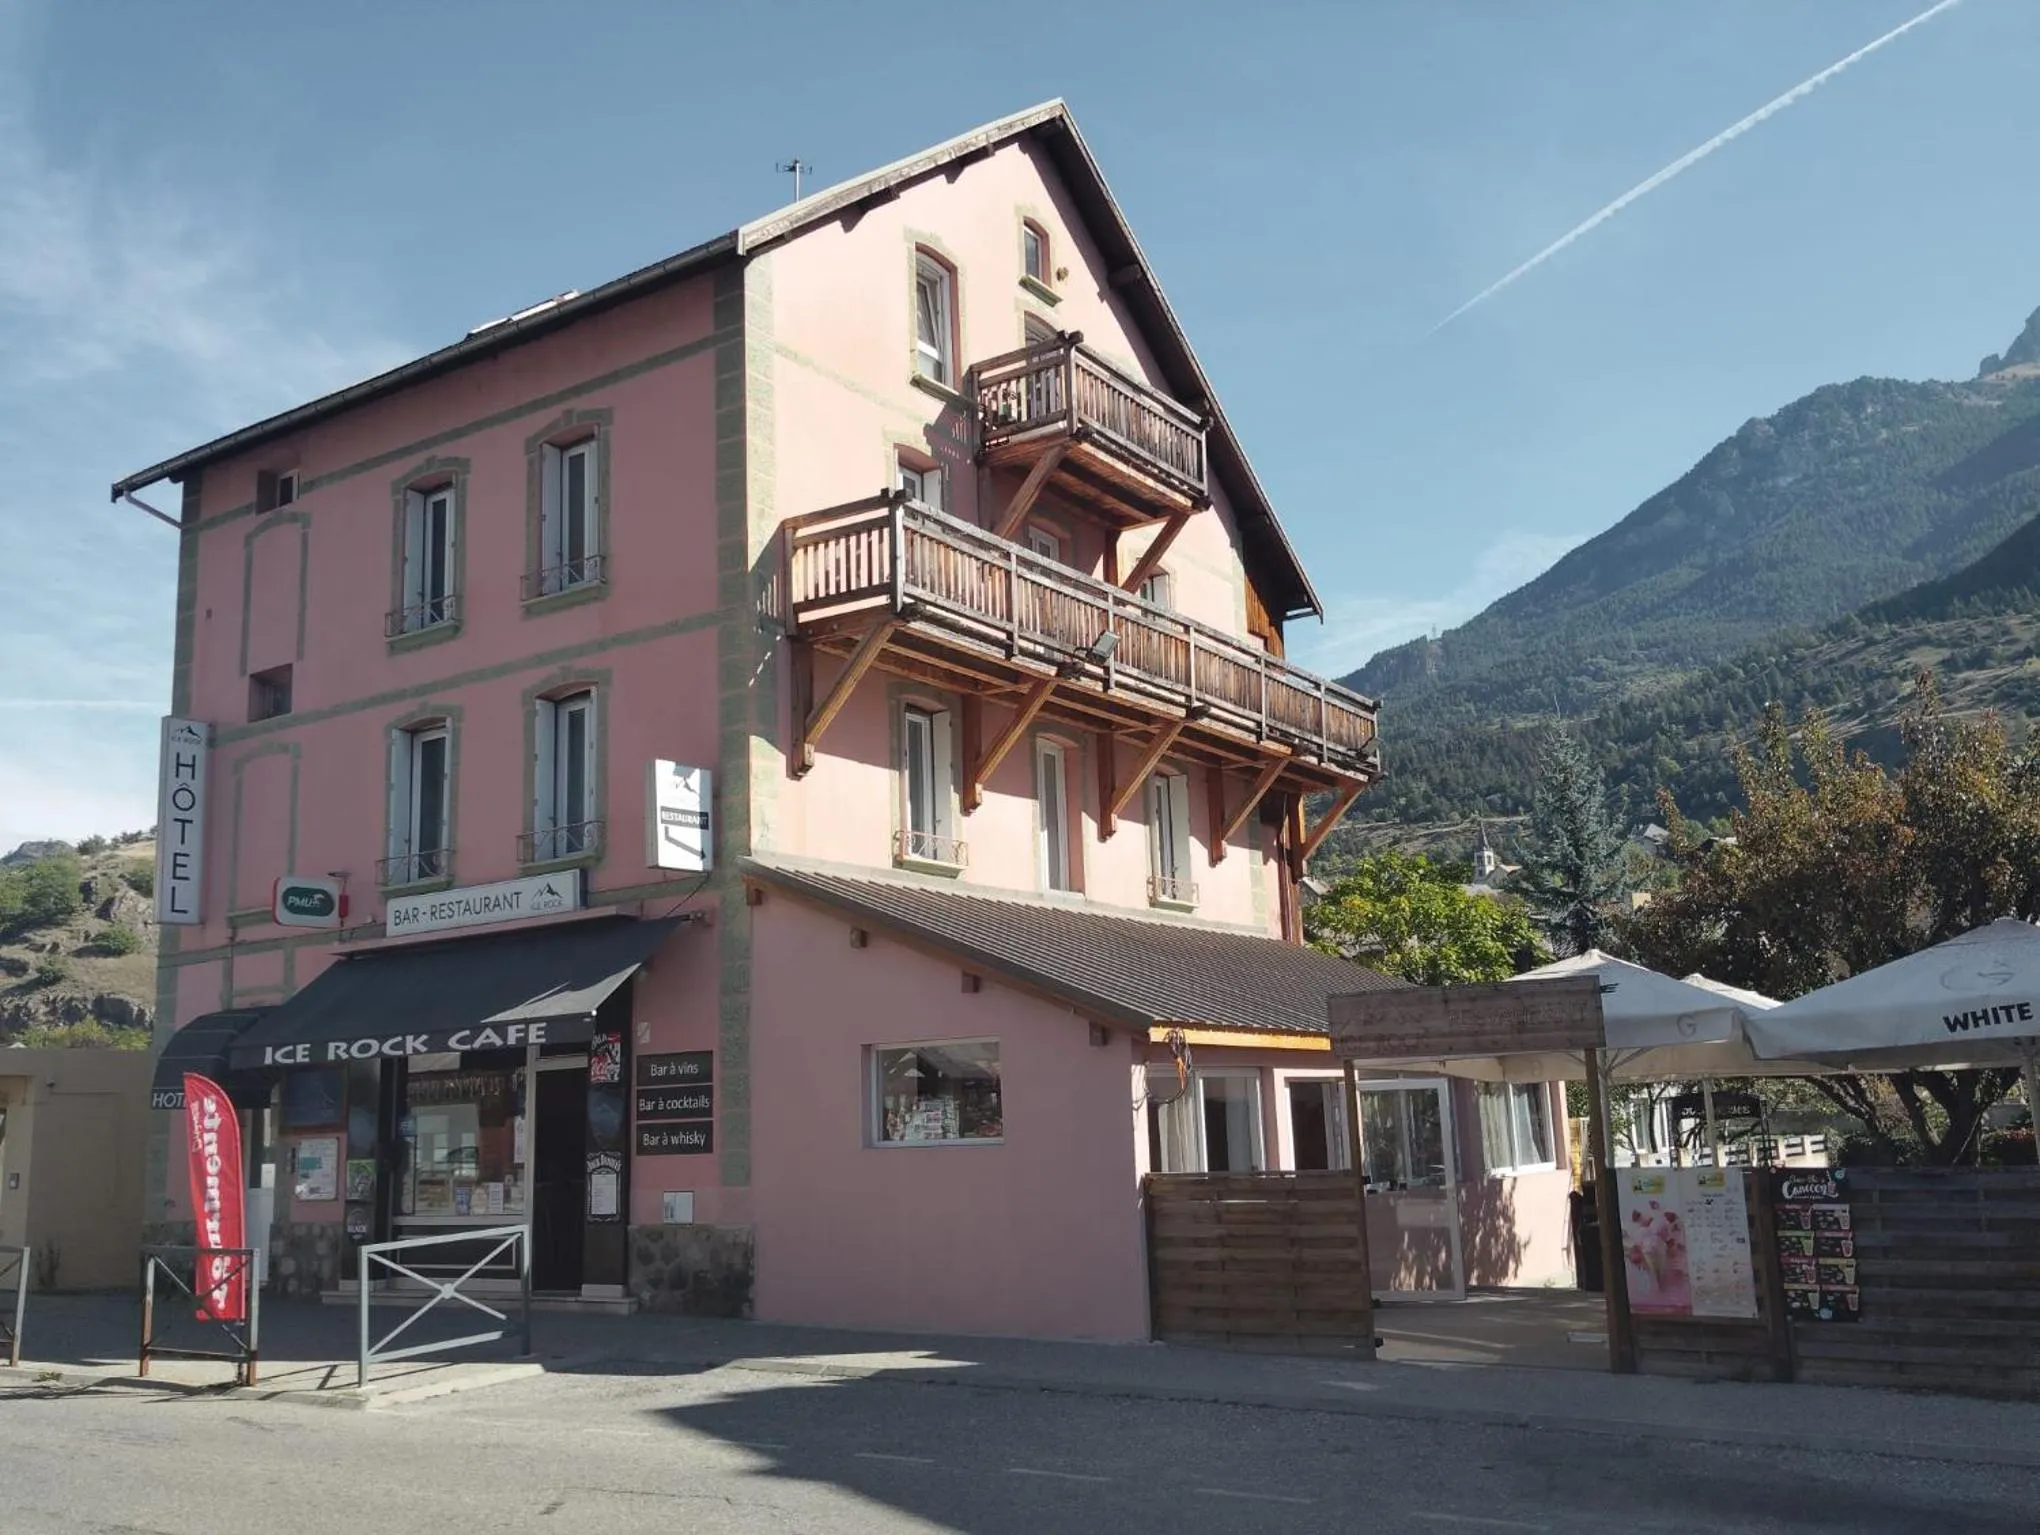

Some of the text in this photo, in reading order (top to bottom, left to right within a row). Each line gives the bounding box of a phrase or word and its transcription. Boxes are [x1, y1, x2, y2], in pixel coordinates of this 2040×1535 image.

[661, 810, 708, 825] RESTAURANT
[171, 752, 196, 914] HÔTEL
[287, 895, 313, 908] PMU
[1942, 1002, 2034, 1033] WHITE
[264, 1022, 547, 1065] ICE ROCK CAFE
[651, 1062, 699, 1076] Bar à vins
[639, 1095, 710, 1111] Bar à cocktails
[643, 1131, 706, 1147] Bar à whisky
